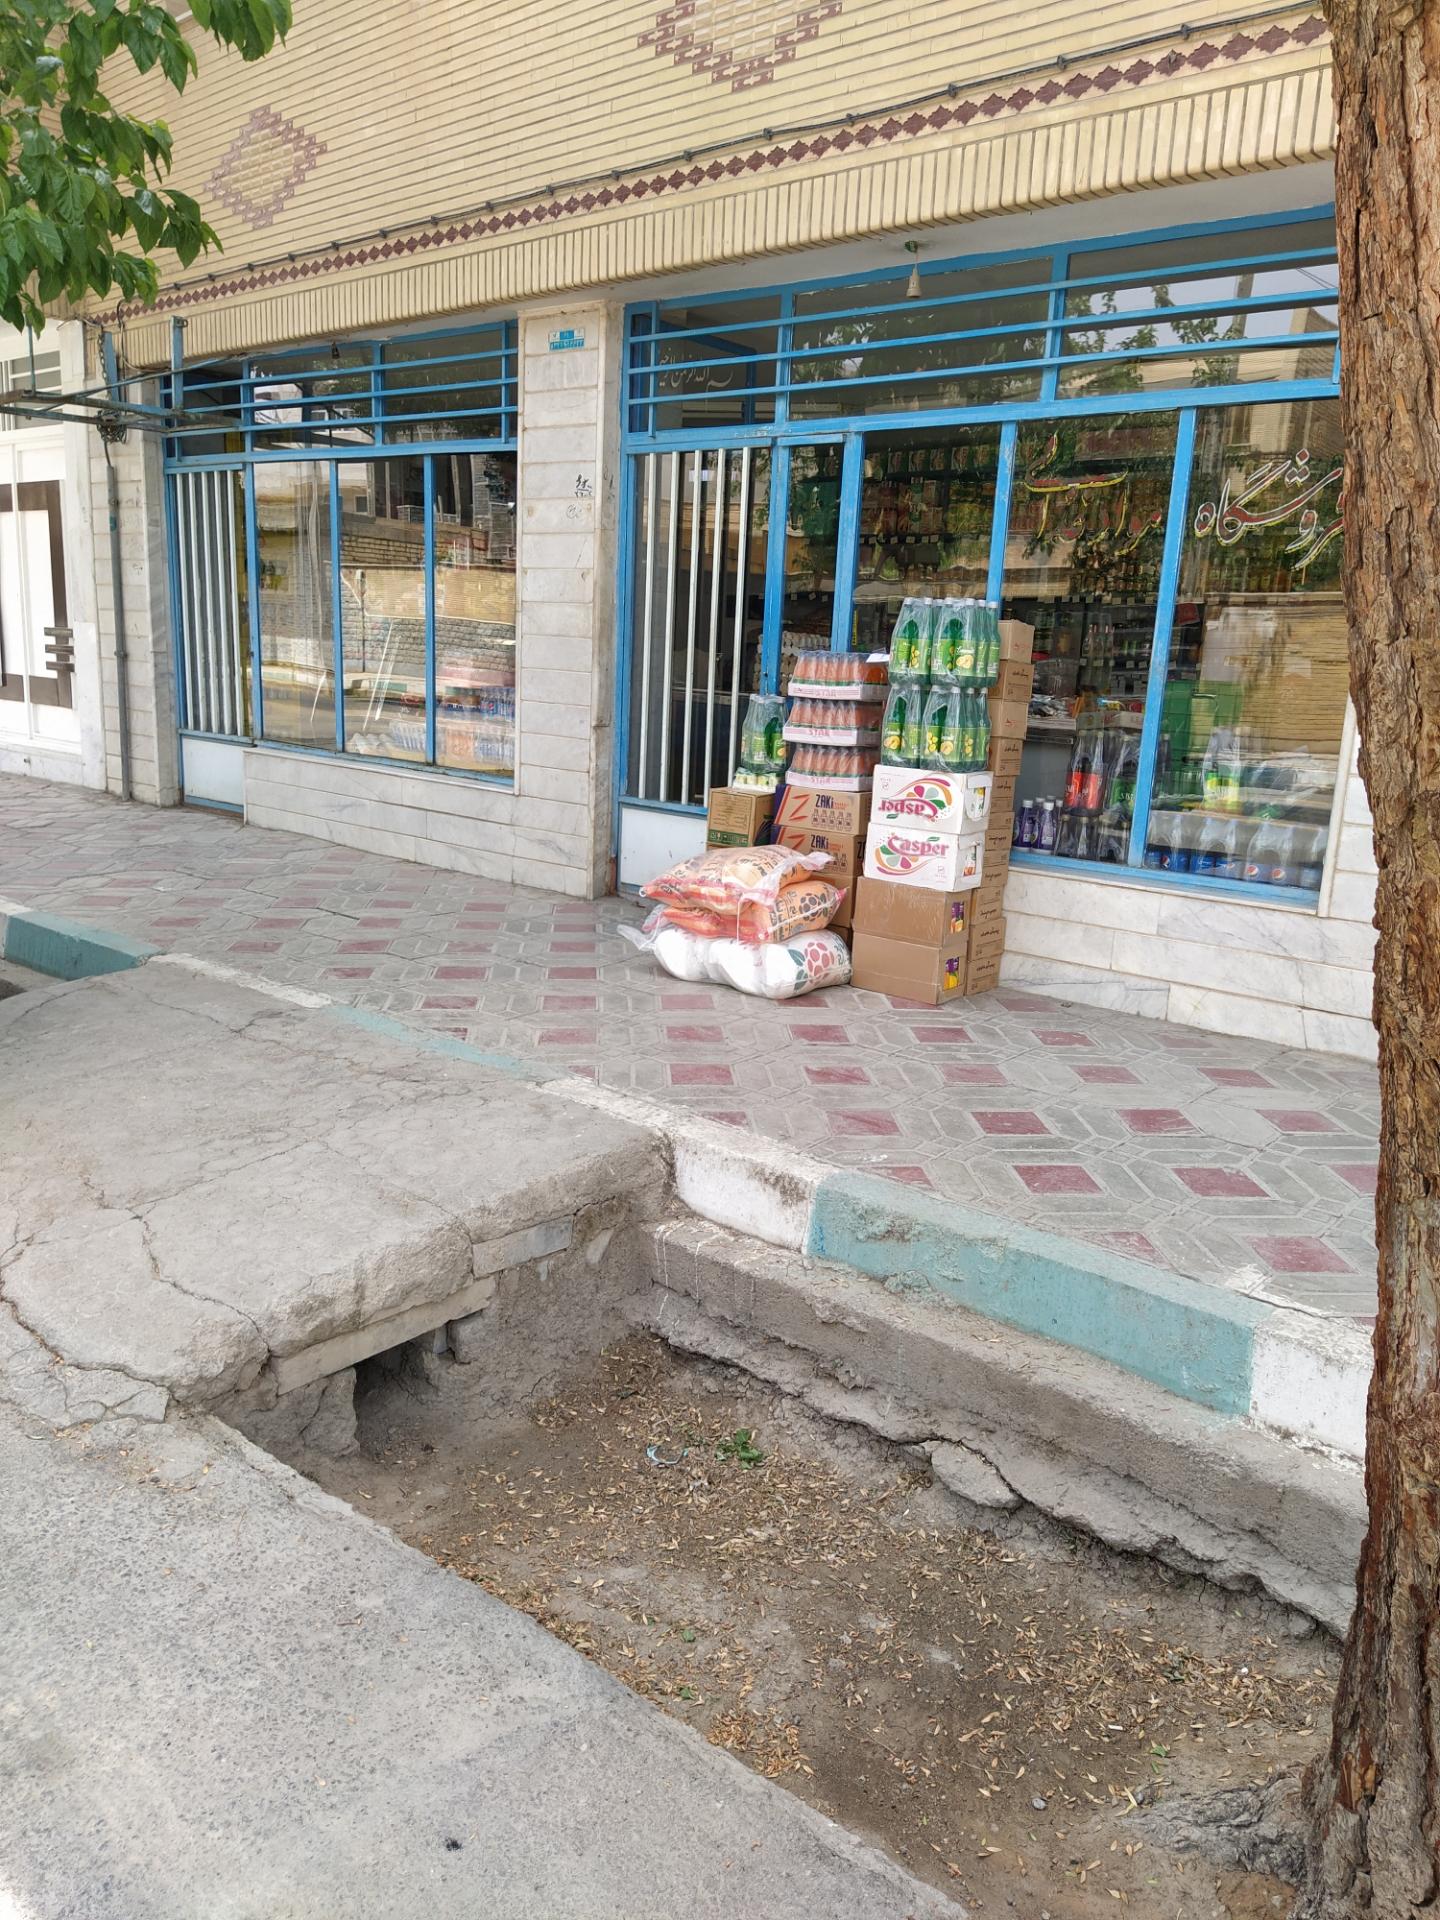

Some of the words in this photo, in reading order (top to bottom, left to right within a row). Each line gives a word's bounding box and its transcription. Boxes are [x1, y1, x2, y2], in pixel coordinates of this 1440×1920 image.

[1195, 448, 1344, 572] روشگاه
[878, 797, 938, 820] Casper
[887, 835, 950, 857] Casper
